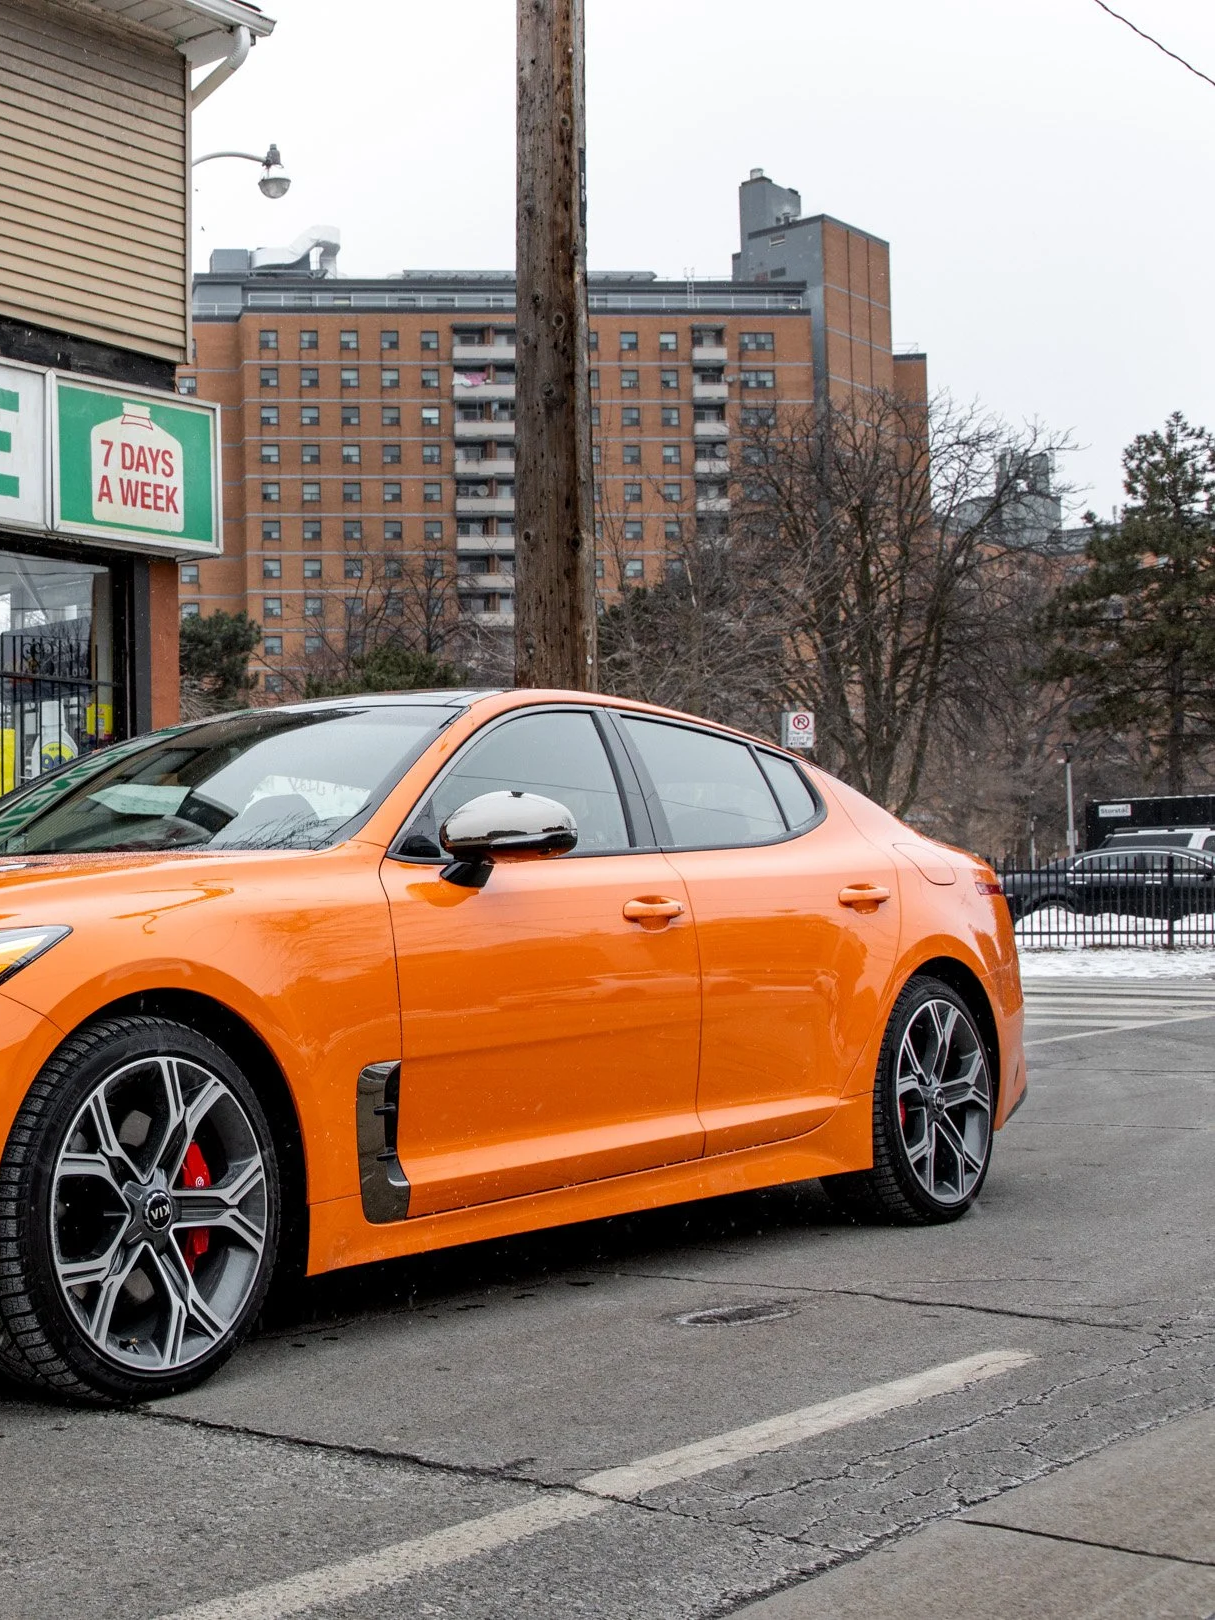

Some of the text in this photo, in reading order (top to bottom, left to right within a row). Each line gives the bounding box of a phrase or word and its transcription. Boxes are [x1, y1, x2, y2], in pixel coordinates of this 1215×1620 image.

[100, 438, 175, 478] 7 DAYS
[97, 474, 179, 515] A WEEK
